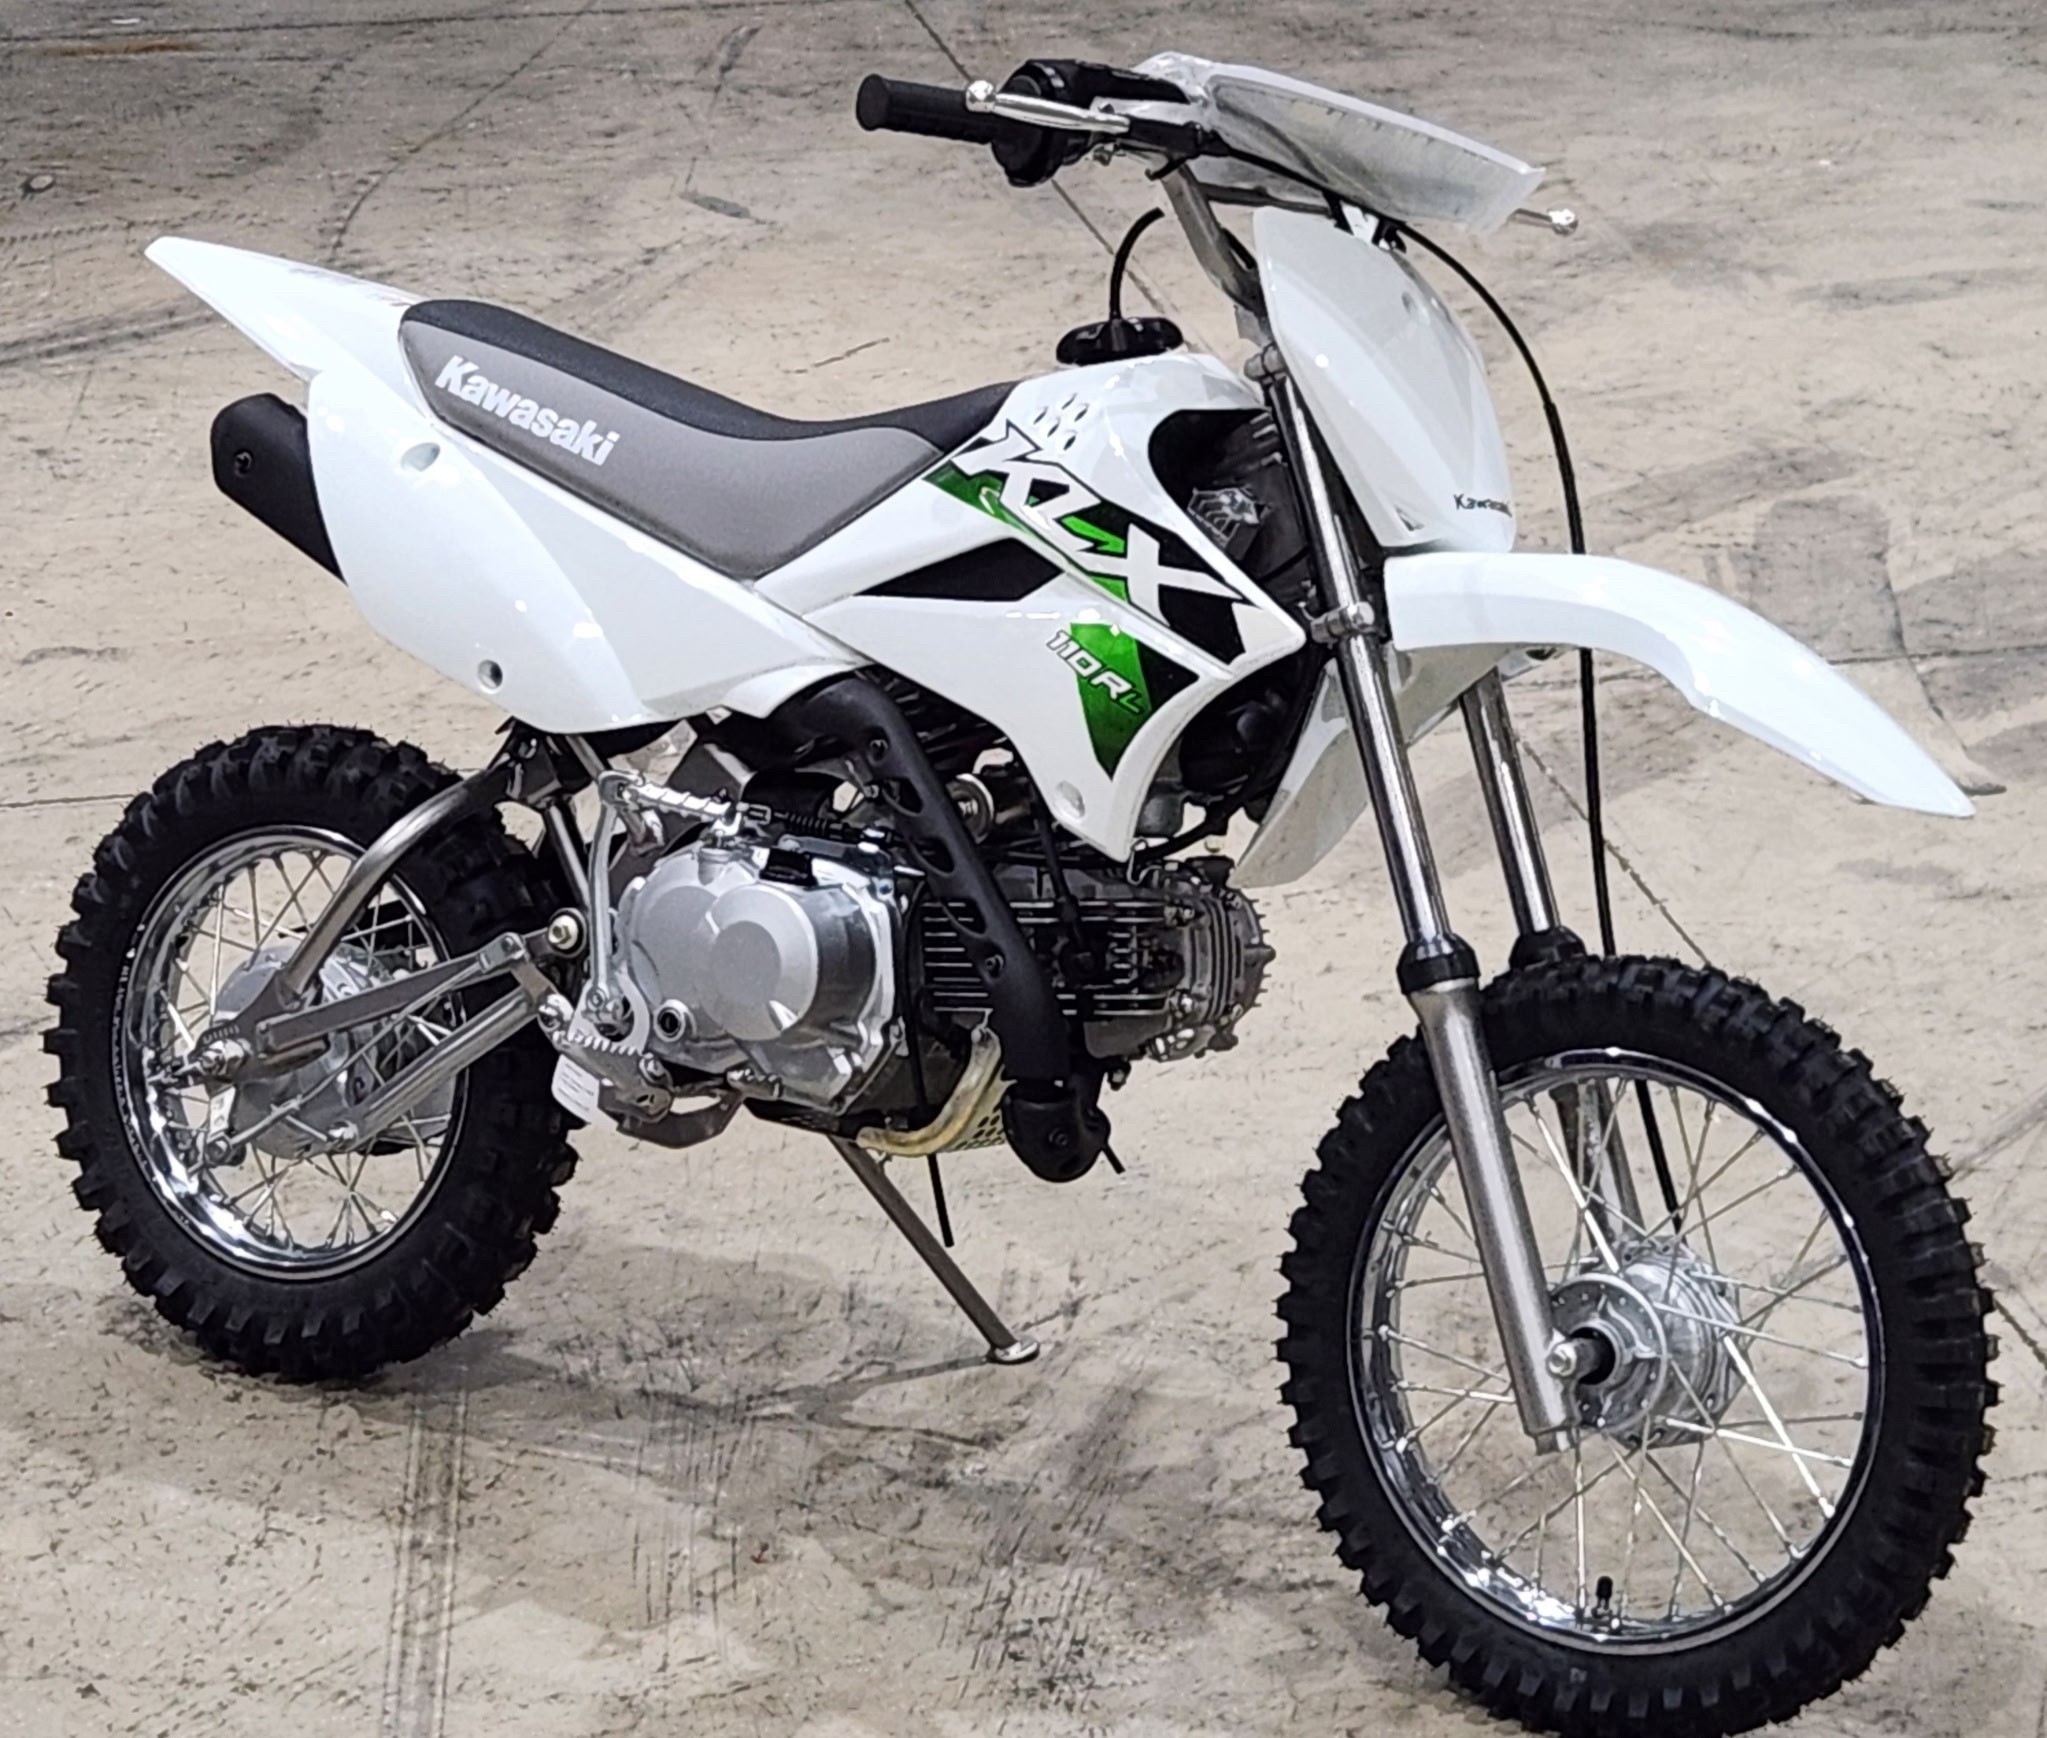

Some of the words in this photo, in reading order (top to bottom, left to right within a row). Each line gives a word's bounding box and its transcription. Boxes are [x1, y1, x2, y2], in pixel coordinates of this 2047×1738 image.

[435, 355, 620, 466] Kawasaki
[952, 420, 1243, 627] KLX
[1453, 493, 1513, 518] Kawas
